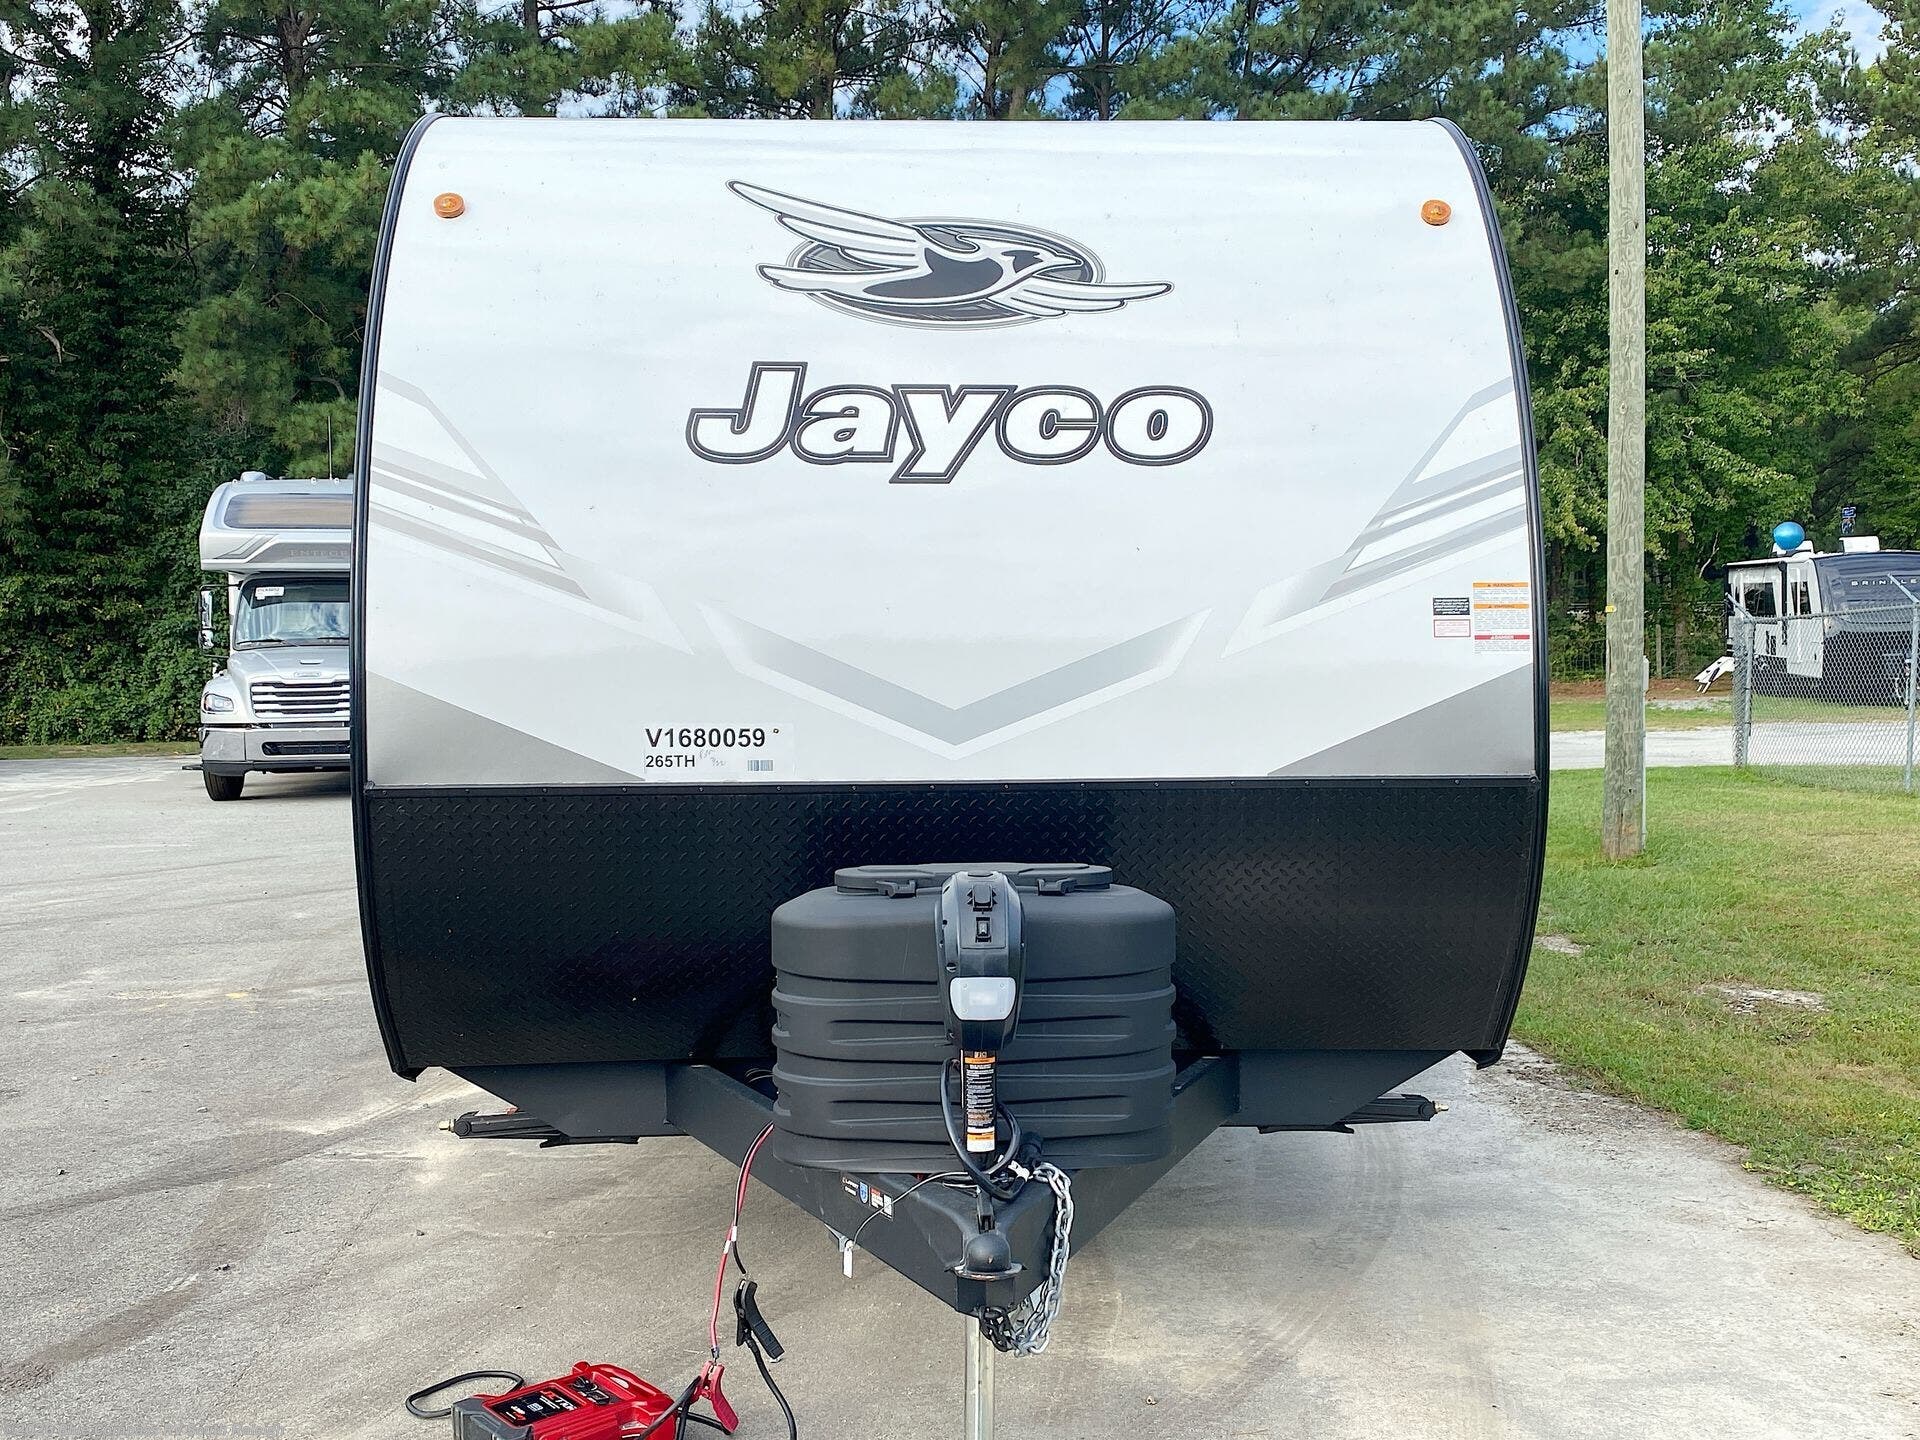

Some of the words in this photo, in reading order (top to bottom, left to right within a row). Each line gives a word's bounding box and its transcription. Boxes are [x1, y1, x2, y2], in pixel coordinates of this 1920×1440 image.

[686, 361, 1213, 484] Jayco
[645, 728, 766, 748] V1680059
[645, 754, 696, 768] 265TH
